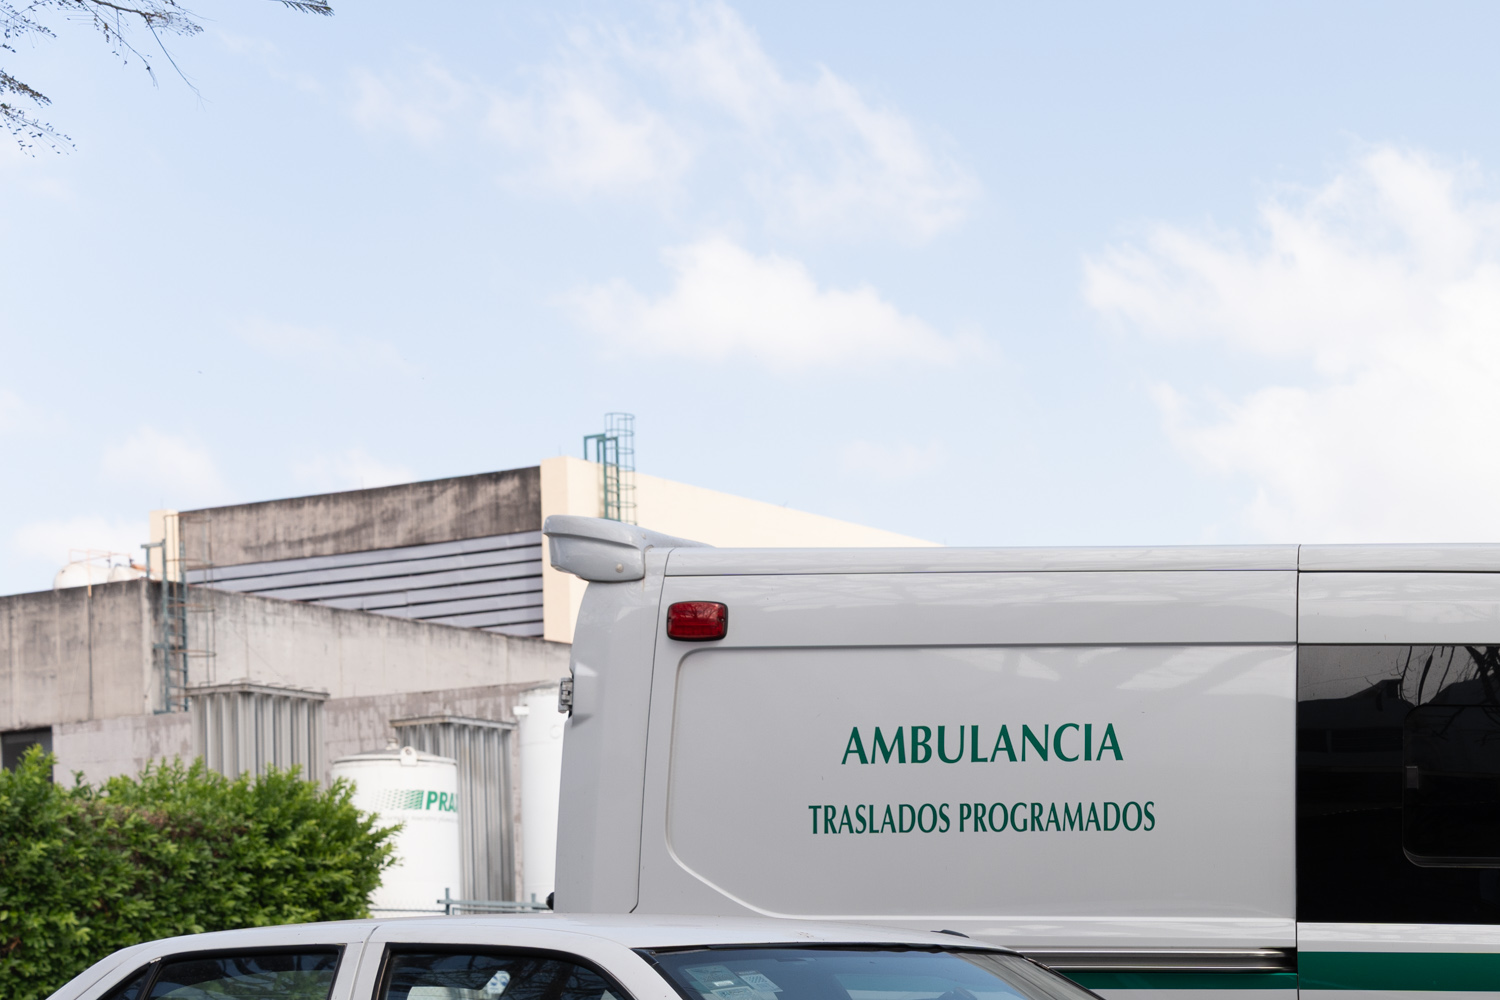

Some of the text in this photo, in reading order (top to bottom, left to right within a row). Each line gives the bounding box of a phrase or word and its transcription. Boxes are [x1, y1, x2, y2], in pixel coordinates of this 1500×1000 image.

[841, 722, 1124, 765] AMBULANCIA
[808, 801, 1156, 834] TRASLADOS PROGRAMADOS
